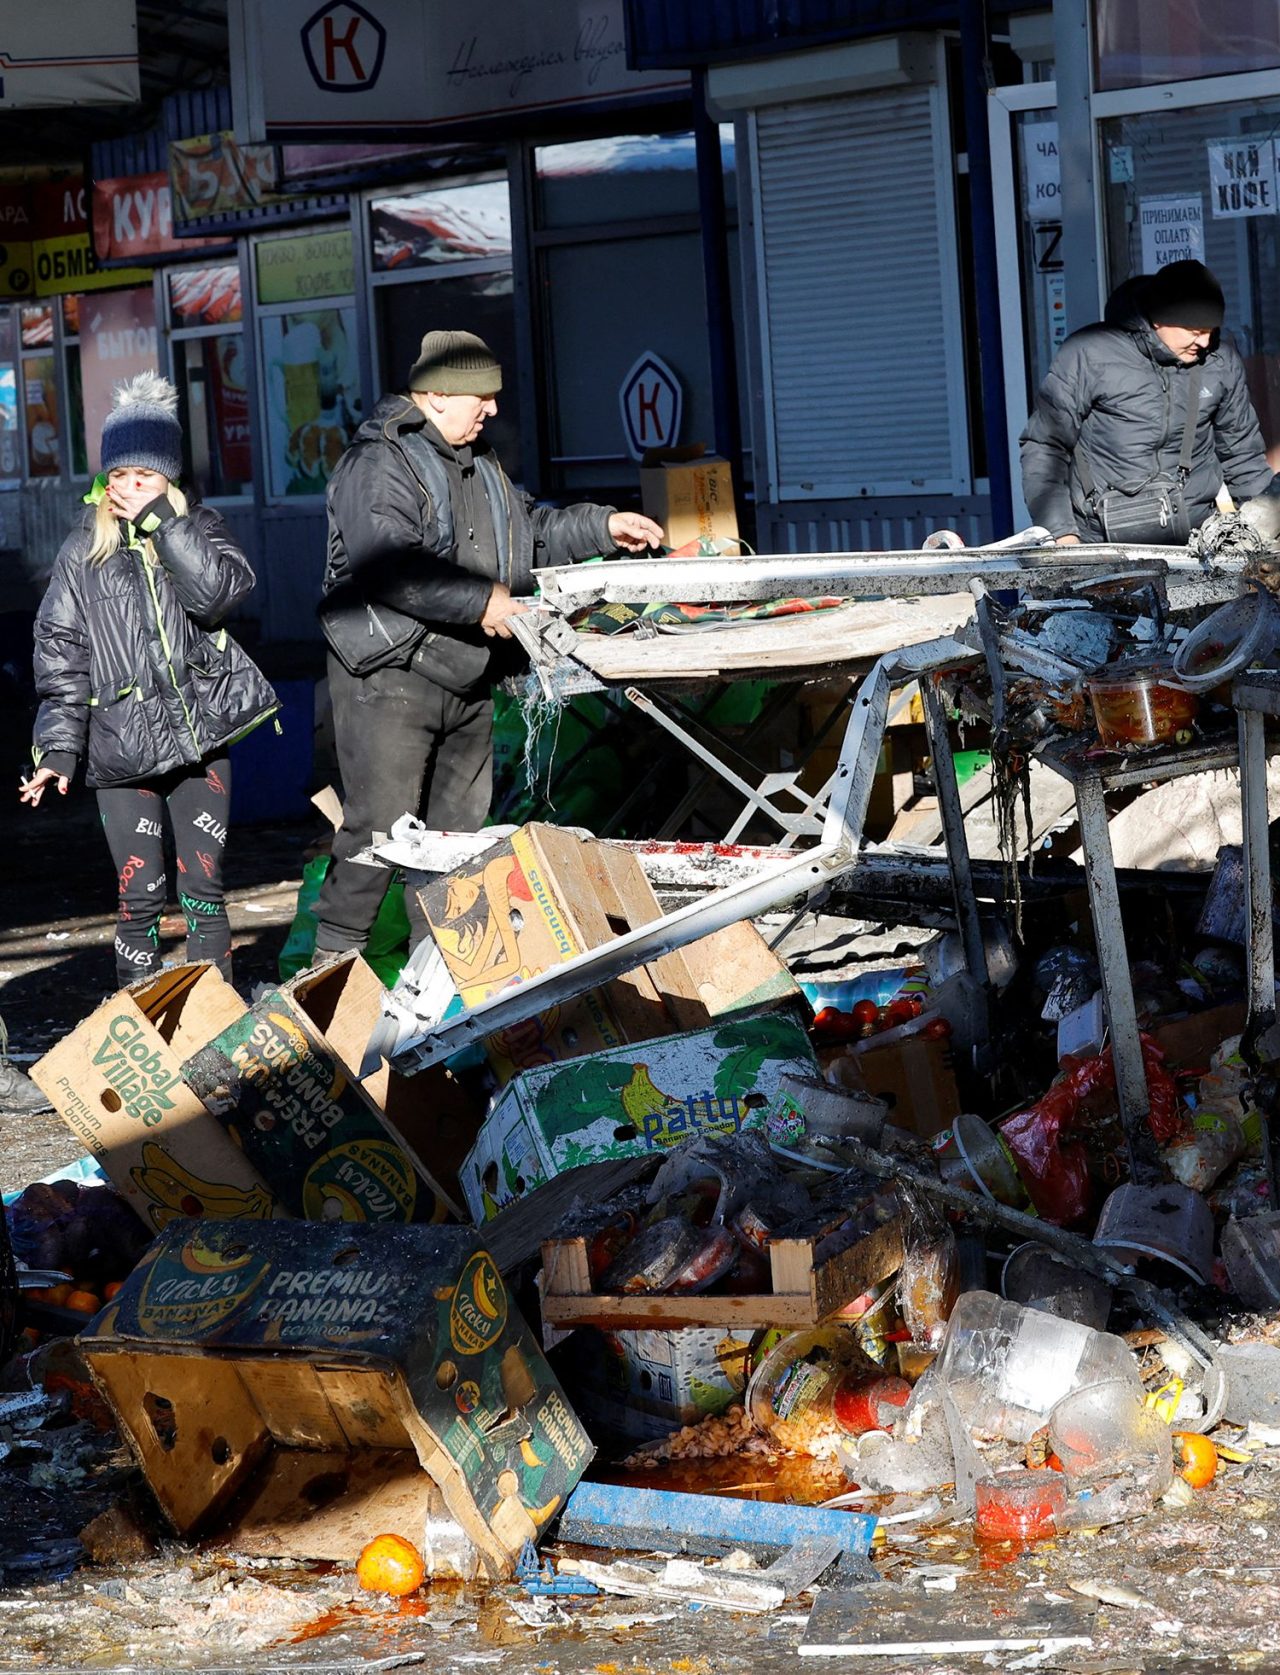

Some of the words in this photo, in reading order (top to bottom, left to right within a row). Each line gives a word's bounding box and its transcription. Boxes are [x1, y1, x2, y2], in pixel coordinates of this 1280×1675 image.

[1037, 141, 1058, 157] ЧА
[1223, 144, 1260, 179] ЧАЙ
[1142, 206, 1202, 225] ПРИНИМАЕМ
[1218, 180, 1270, 212] КОФЕ
[1036, 225, 1064, 268] Z
[1154, 228, 1191, 244] ОПЛАТУ
[707, 478, 720, 505] BIC
[528, 869, 572, 955] bananas
[109, 1014, 183, 1090] Global
[288, 1033, 334, 1085] ECUADOR
[92, 1035, 163, 1128] Village
[250, 1022, 345, 1128] BANANAS
[56, 1077, 103, 1131] Premium
[642, 1089, 742, 1149] patty
[64, 1106, 109, 1157] bananas
[348, 1145, 412, 1207] BANANAS
[142, 1298, 237, 1319] BANANAS
[155, 1273, 239, 1304] Vicky
[280, 1325, 350, 1337] ECUADOR
[451, 1311, 486, 1350] BANANAS
[459, 1293, 493, 1335] Vicky
[536, 1404, 578, 1471] BANANAS
[545, 1390, 587, 1457] PREMIUM
